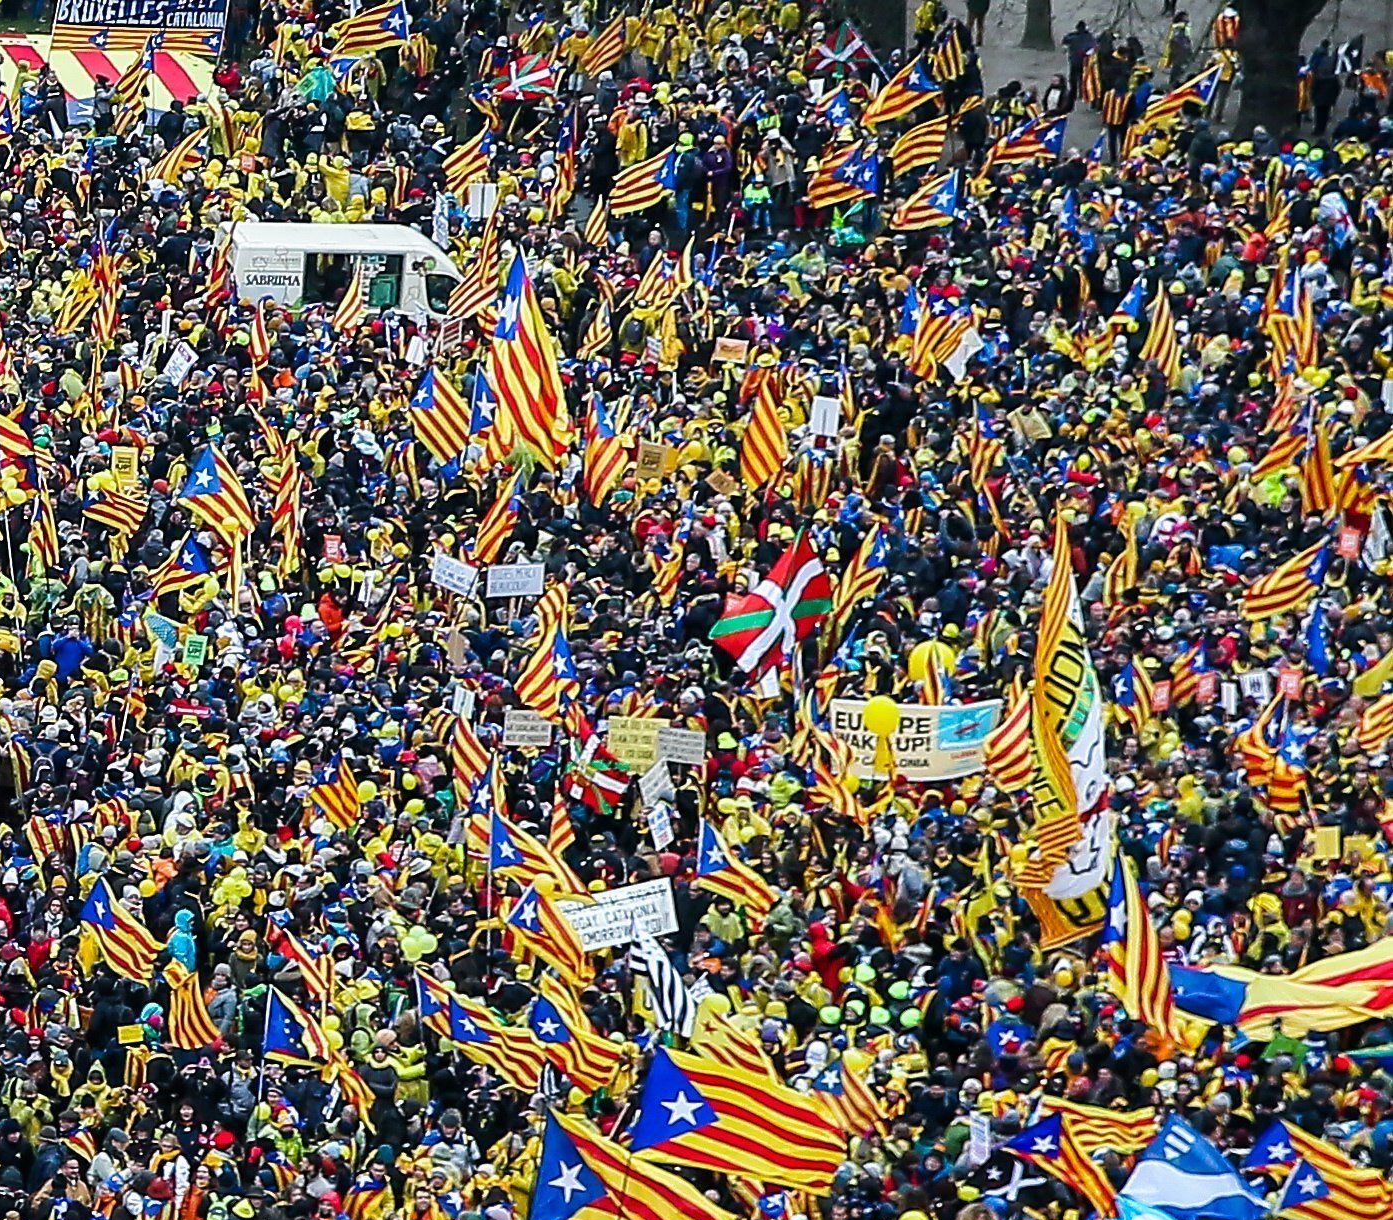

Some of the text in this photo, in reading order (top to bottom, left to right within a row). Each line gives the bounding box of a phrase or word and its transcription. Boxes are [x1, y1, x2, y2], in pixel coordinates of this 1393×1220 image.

[166, 11, 225, 28] CATALONIA
[835, 711, 931, 735] EUPE
[836, 733, 932, 753] WAK UP!
